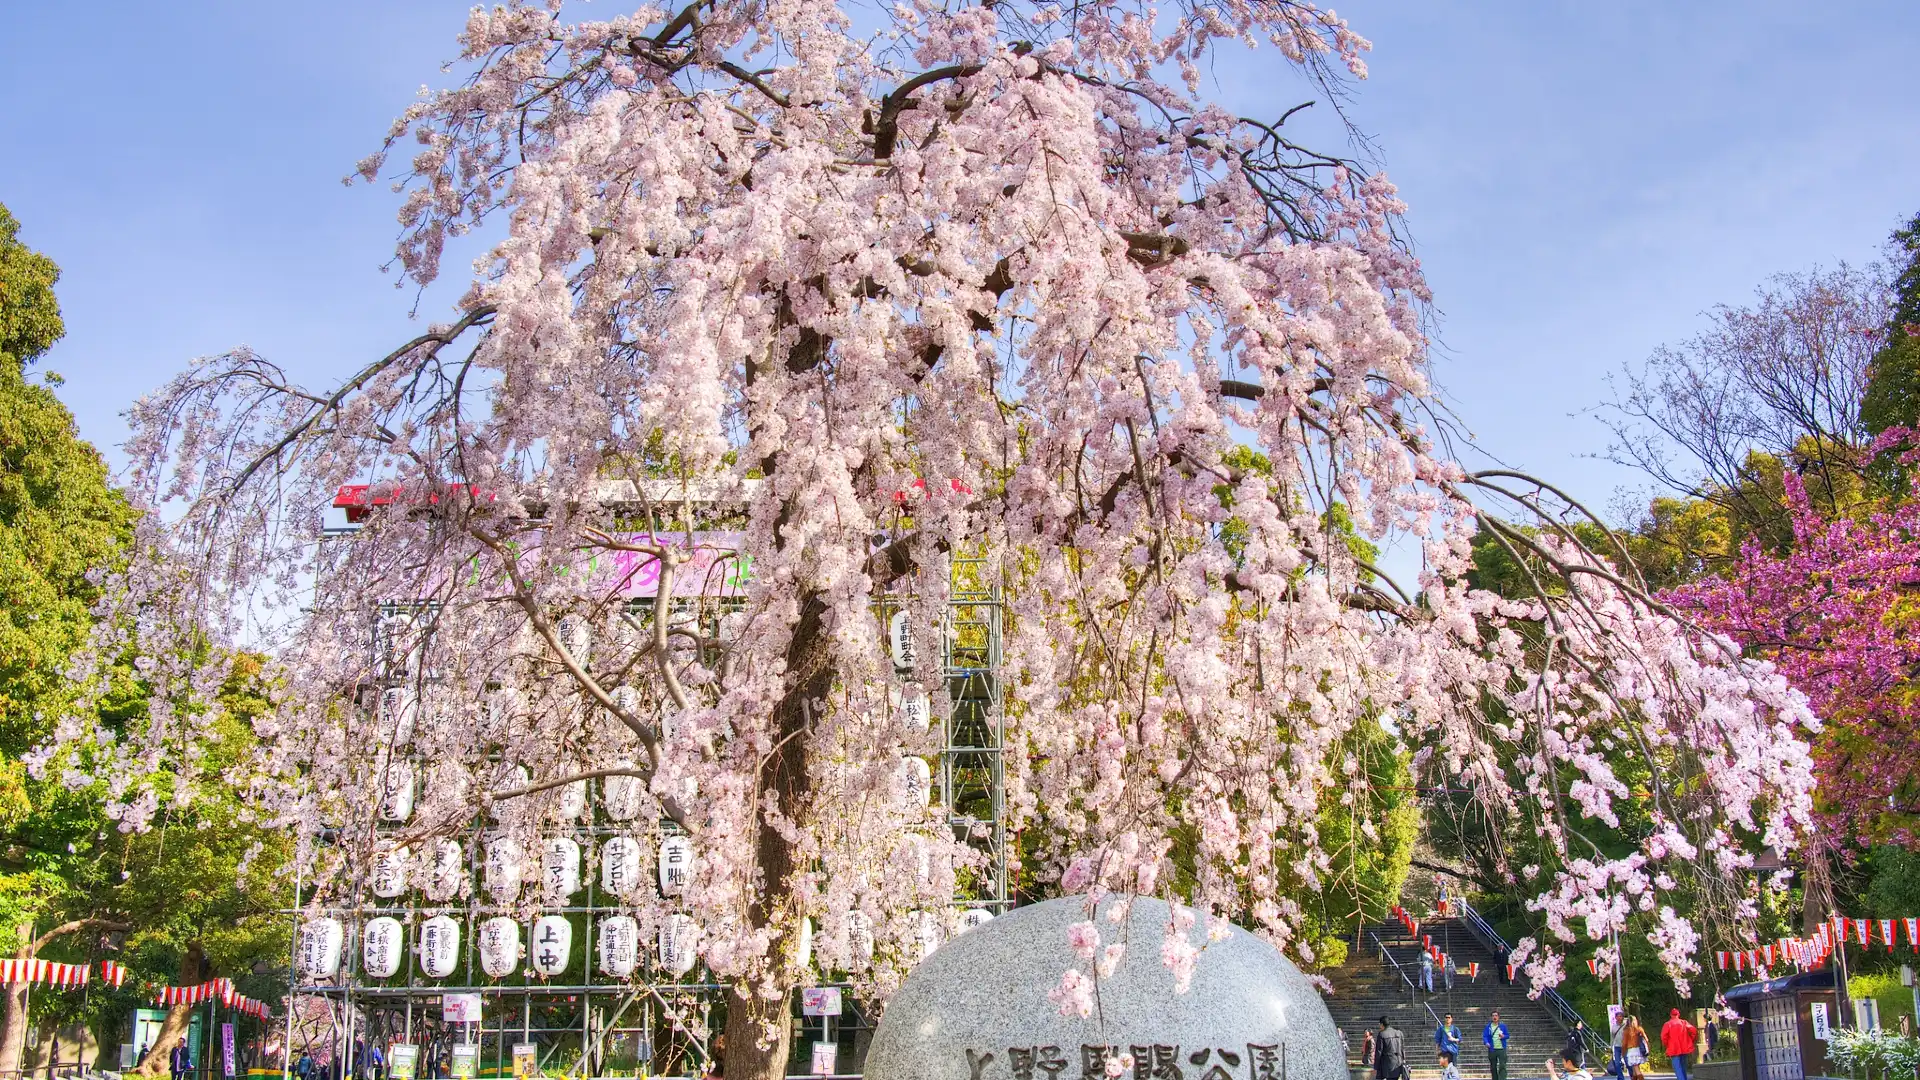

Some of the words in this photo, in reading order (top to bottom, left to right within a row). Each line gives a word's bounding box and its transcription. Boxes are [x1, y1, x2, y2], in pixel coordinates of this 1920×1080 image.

[366, 931, 377, 973] 連合会
[539, 925, 560, 971] 上中
